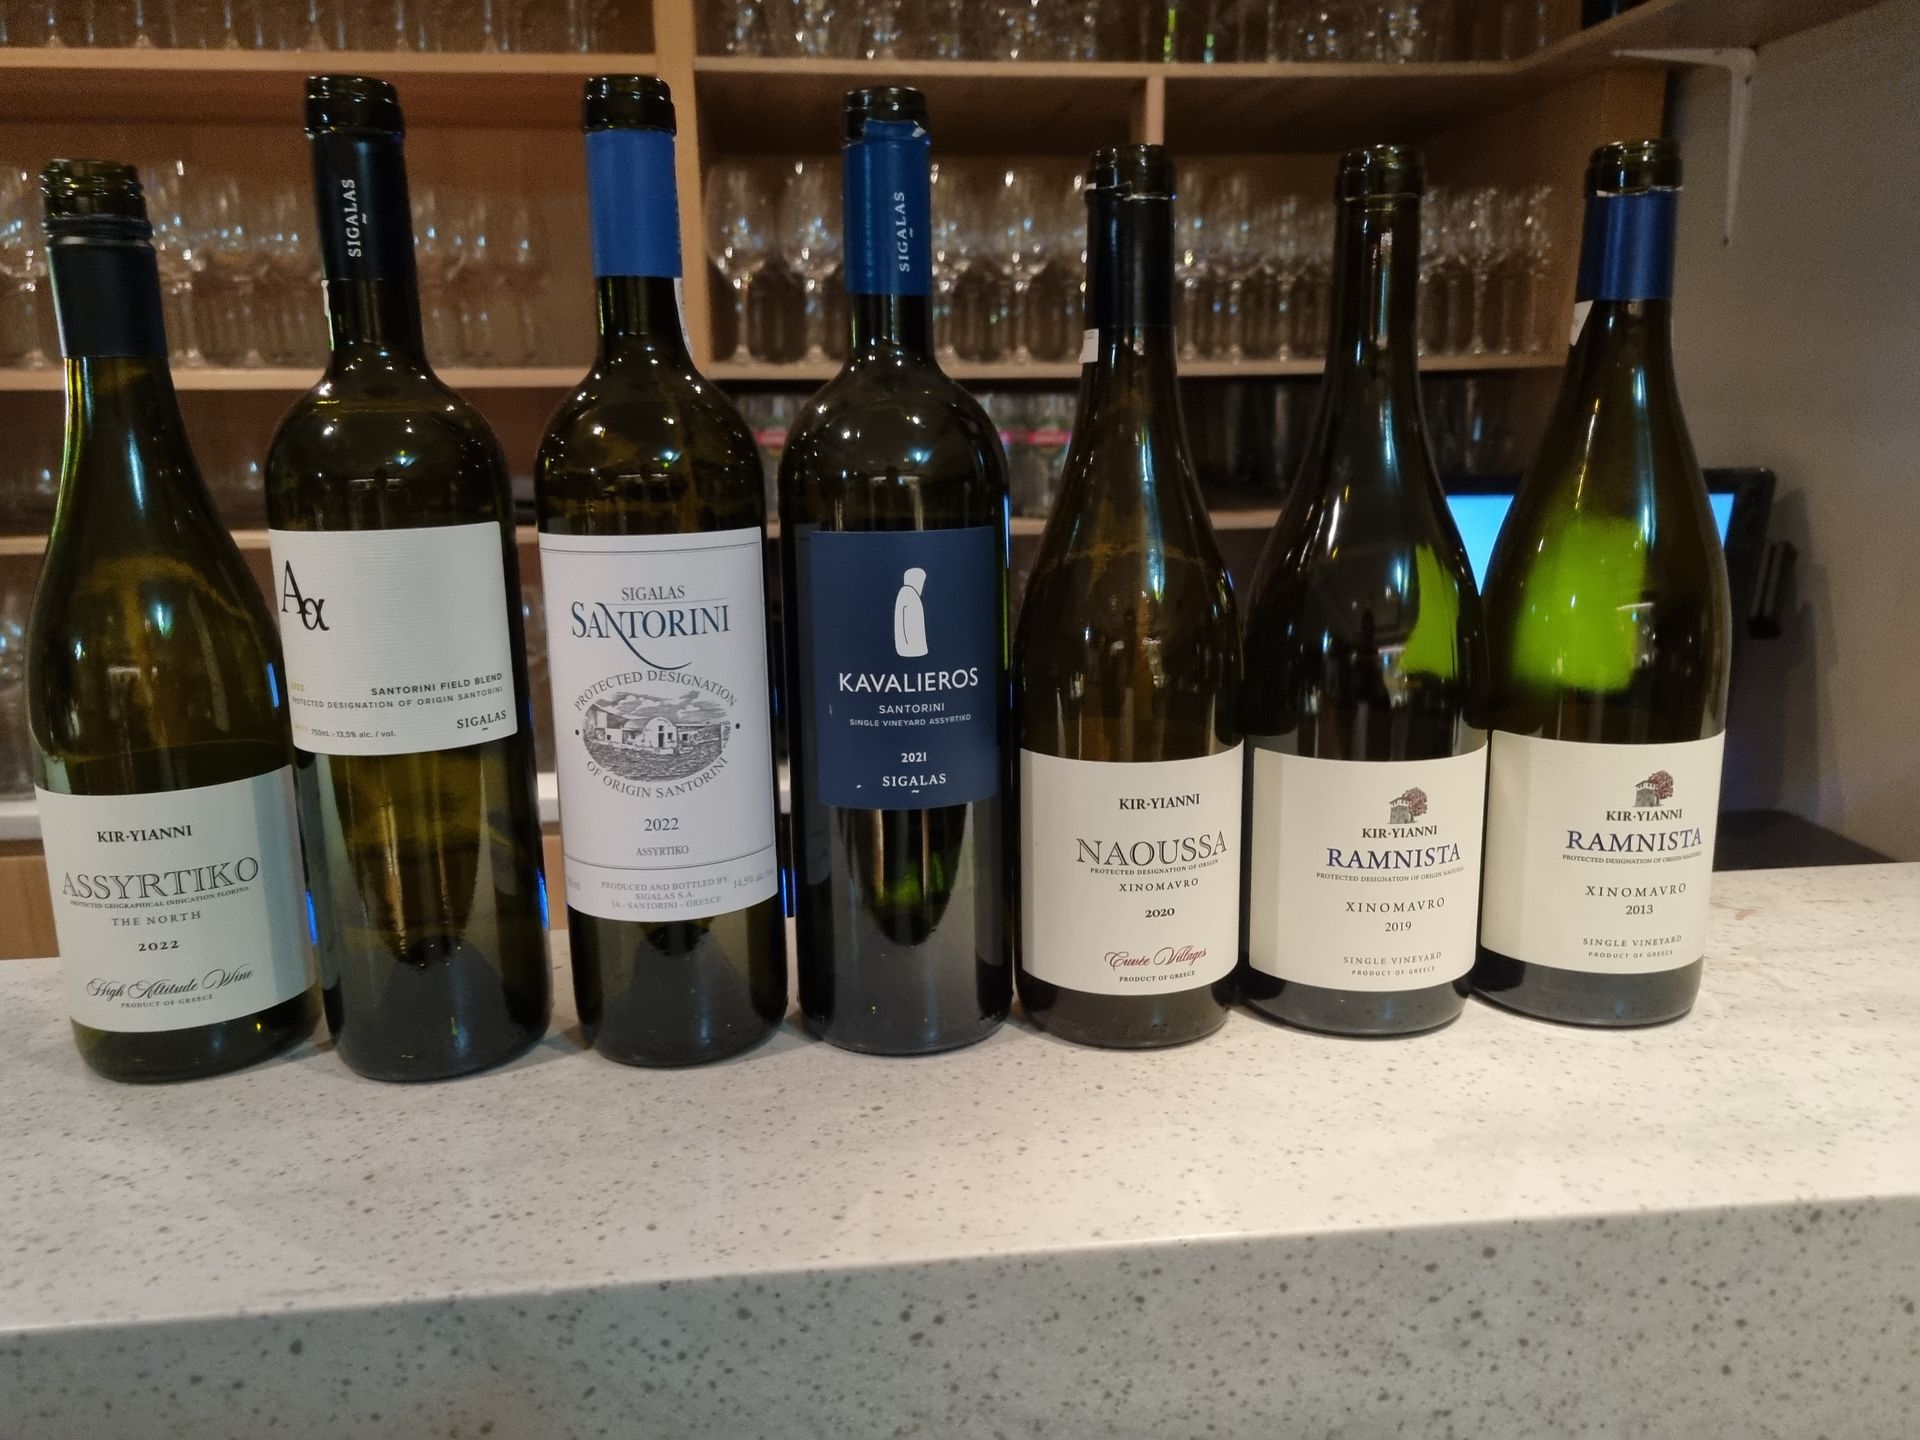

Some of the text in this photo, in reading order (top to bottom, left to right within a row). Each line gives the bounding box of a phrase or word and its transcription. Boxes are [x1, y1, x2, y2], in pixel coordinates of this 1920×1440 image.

[341, 179, 362, 258] SIGALAS
[894, 191, 910, 272] SIGALAS
[621, 585, 685, 601] SIGALAS
[371, 672, 503, 696] SANTORINI FIELD BLEND
[839, 667, 979, 693] KAVALIEROS
[327, 700, 393, 709] DESIGNATION
[398, 699, 413, 707] OF
[417, 695, 454, 706] ORIGIN
[457, 686, 503, 701] SANTORINI
[574, 670, 738, 712] PROTECTED DESIGNATION
[878, 703, 945, 714] SANTORINI
[456, 709, 507, 729] SIGALAS
[849, 713, 972, 727] SINGLE VINEYARD ASSYRTIKO
[901, 752, 928, 763] 2021
[586, 756, 728, 799] OF ORIGIN SANTORINI
[882, 773, 947, 788] SIGALAS
[644, 817, 680, 832] 2022
[1566, 827, 1702, 853] RAMNISTA
[636, 845, 690, 857] ASSYRTIKO
[1076, 830, 1228, 867] NAOUSSA
[1326, 842, 1462, 870] RAMNISTA
[1562, 854, 1605, 864] PROTECTED
[62, 856, 259, 900] ASSYRTIKO
[1090, 867, 1135, 876] PROTECTED
[1137, 866, 1187, 876] DESIGNATION
[1316, 872, 1359, 882] PROTECTED
[601, 880, 648, 892] PRODUCED
[650, 883, 670, 891] AND
[672, 878, 715, 890] BOTTLED
[1118, 877, 1200, 892] XINOMAVRO
[1585, 883, 1687, 898] XINOMAVRO
[104, 900, 164, 909] GEOGRAPHICAL
[166, 893, 215, 906] INDICATION
[216, 886, 250, 898] FLORINA
[627, 901, 678, 910] SANTORINI
[686, 896, 722, 908] GREECE
[635, 892, 676, 900] SIGALAS
[1345, 897, 1446, 913] XINOMAVRO
[1625, 904, 1654, 915] 2013
[112, 911, 202, 927] THE NORTH
[1145, 907, 1176, 919] 2020
[1384, 921, 1413, 932] 2019
[138, 940, 180, 952] 2022
[1583, 934, 1683, 947] SINGLE VINEYARD
[1104, 945, 1207, 971] Cuvée Villages
[1343, 951, 1443, 966] SINGLE VINEYARD
[1588, 951, 1628, 959] PRODUCT
[1647, 950, 1673, 958] GREECE
[1119, 975, 1157, 983] PRODUCT
[1169, 970, 1196, 980] GREECE
[1351, 969, 1391, 977] PRODUCT
[1408, 966, 1436, 975] GREECE
[86, 964, 254, 1001] High Altitude Wine
[121, 1000, 160, 1008] PRODUCT
[178, 994, 213, 1005] GREECE
